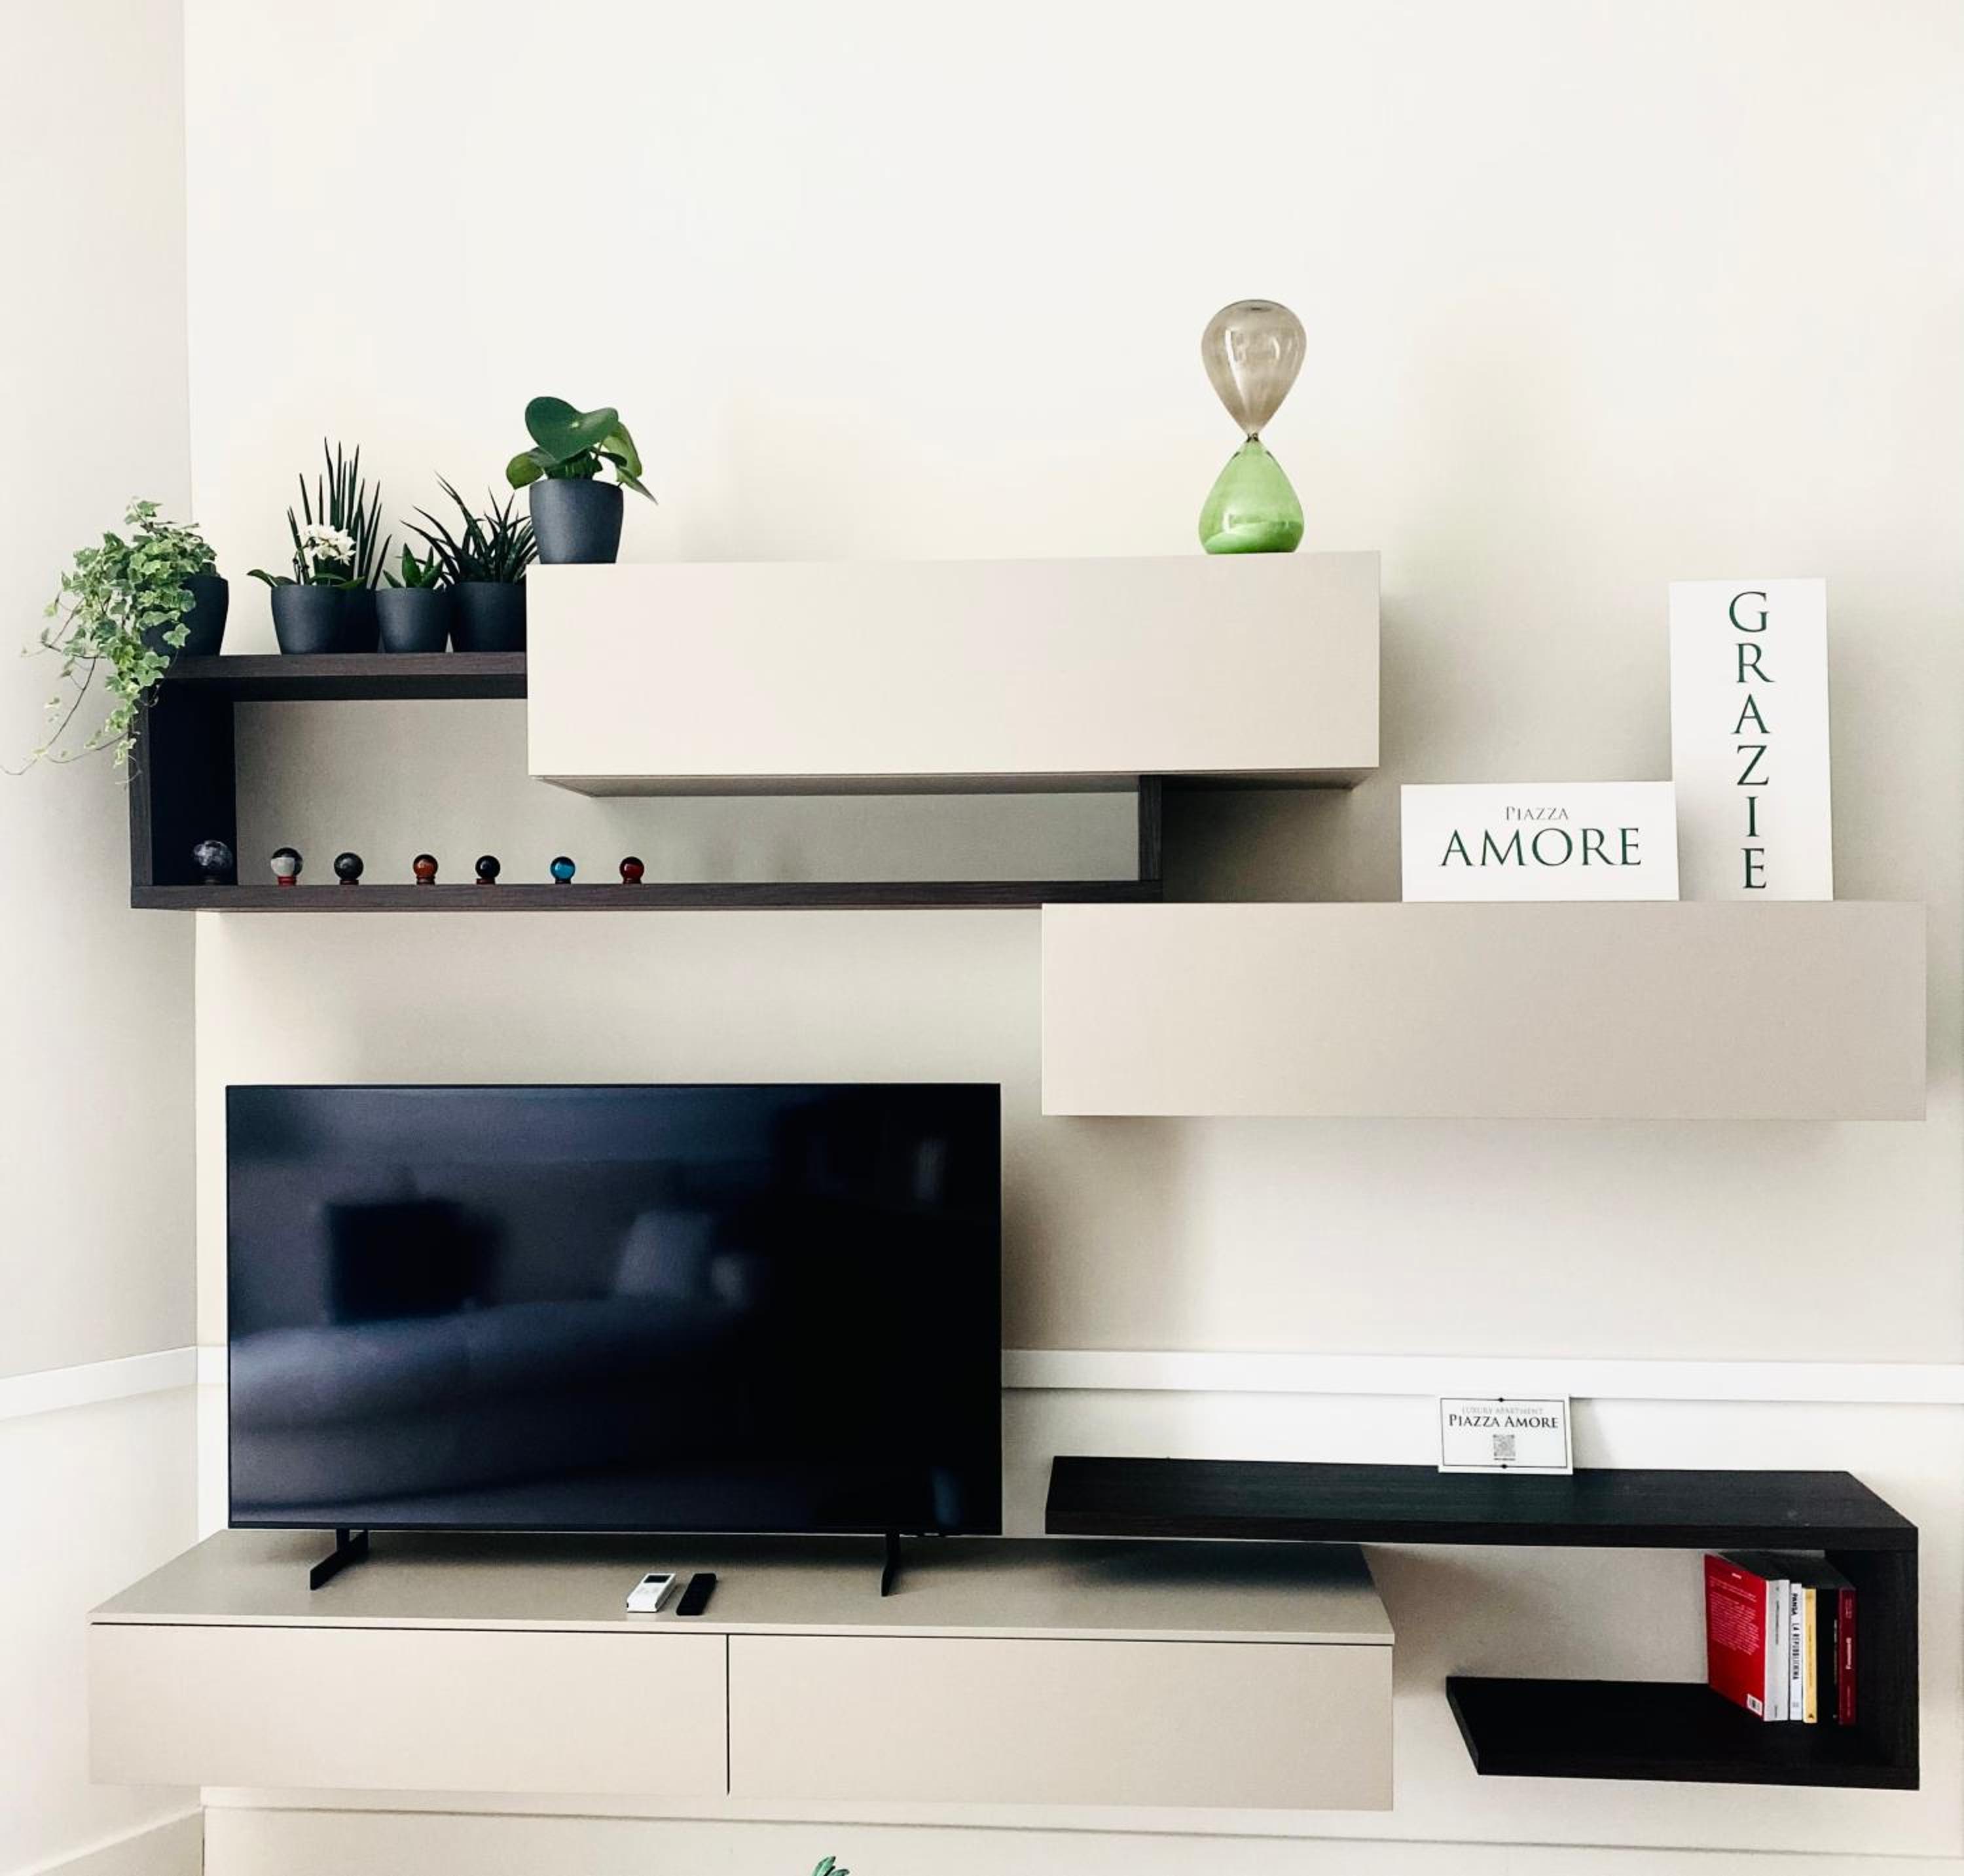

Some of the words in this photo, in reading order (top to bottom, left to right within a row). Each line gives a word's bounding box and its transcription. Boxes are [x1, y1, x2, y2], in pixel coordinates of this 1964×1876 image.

[1728, 591, 1775, 890] GRAZIE
[1505, 806, 1569, 821] PIAZZA
[1440, 827, 1643, 867] AMORE
[1449, 1414, 1500, 1428] PIAZZA
[1504, 1415, 1559, 1428] AMORE
